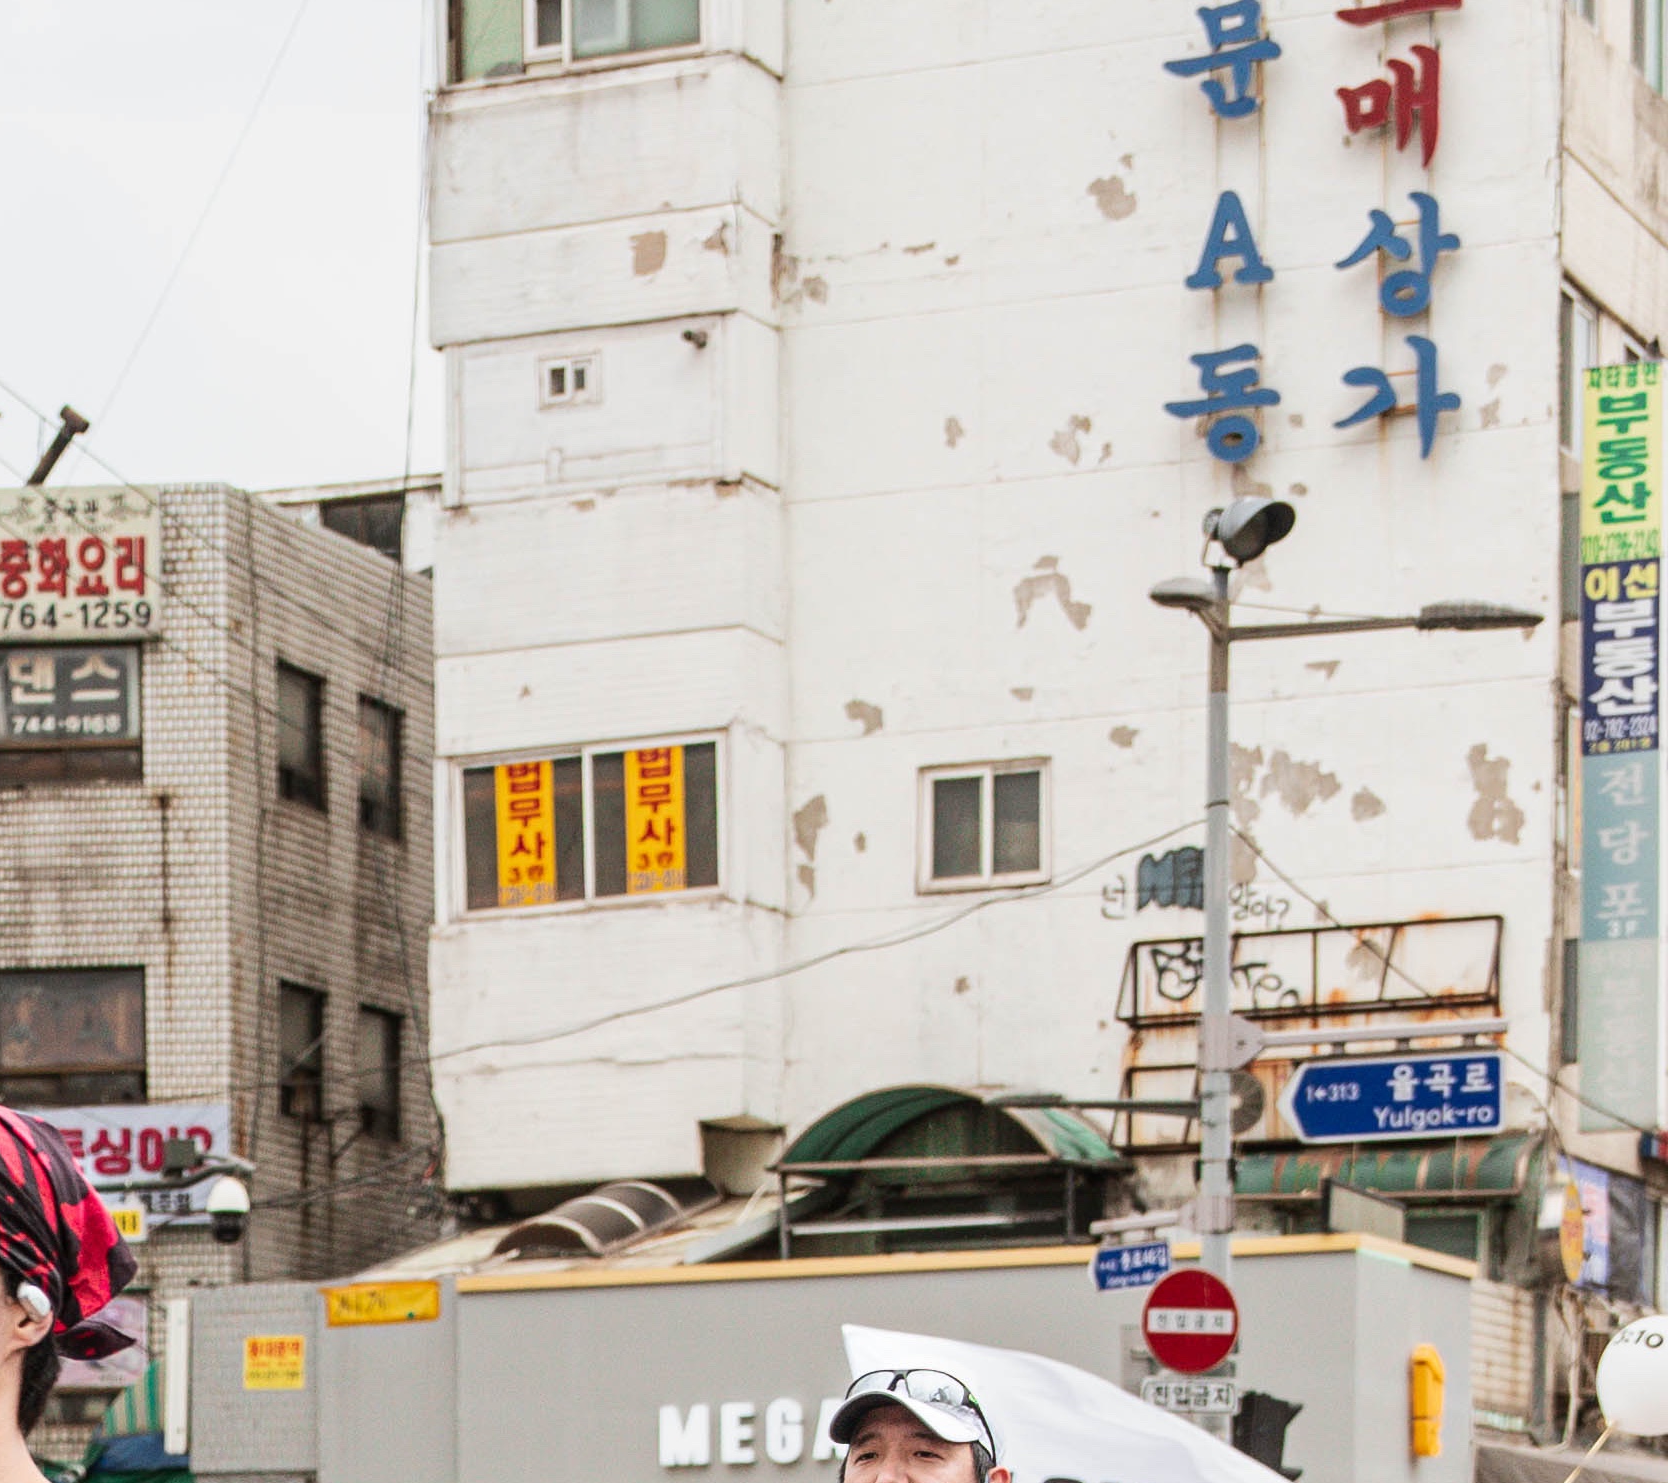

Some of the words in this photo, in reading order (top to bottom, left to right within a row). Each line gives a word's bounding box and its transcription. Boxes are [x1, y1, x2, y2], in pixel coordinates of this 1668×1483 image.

[1592, 391, 1653, 525] 부동산
[0, 602, 152, 629] 764-1259
[7, 655, 121, 704] 댄스
[1587, 597, 1657, 717] 부동산
[1596, 762, 1650, 921] 전당포
[1385, 1061, 1495, 1102] 율곡로
[1373, 1102, 1495, 1131] Yulgok-ro
[658, 1396, 848, 1466] MEGA
